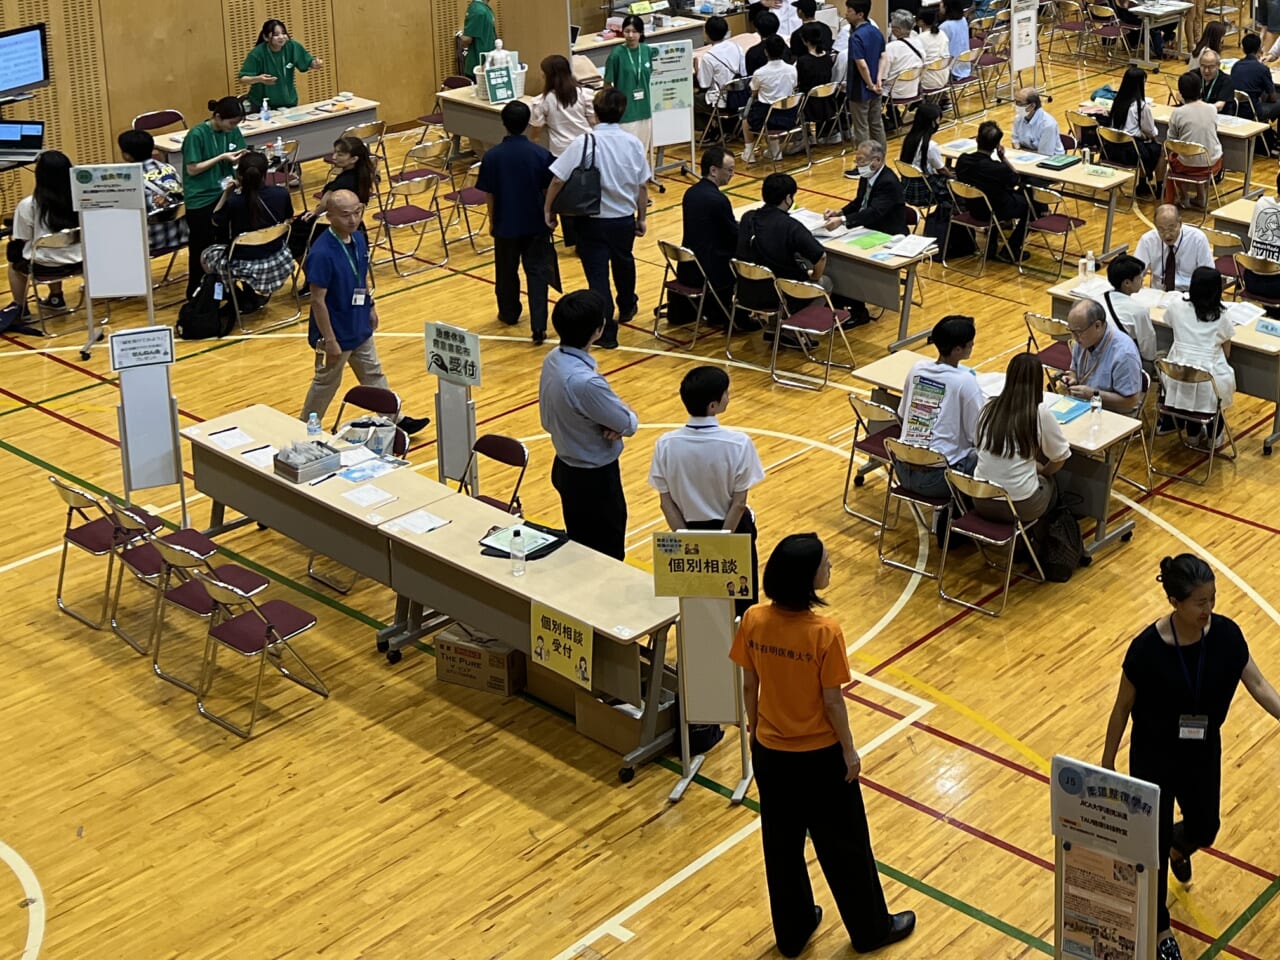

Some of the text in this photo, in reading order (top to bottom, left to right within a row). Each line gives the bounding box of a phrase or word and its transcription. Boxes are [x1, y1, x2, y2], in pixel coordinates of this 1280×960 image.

[449, 356, 477, 379] 受付
[668, 558, 738, 574] 個別相談
[541, 614, 584, 647] 個別相談
[552, 638, 573, 660] 受付
[1086, 785, 1153, 817] 柔道整復学科
